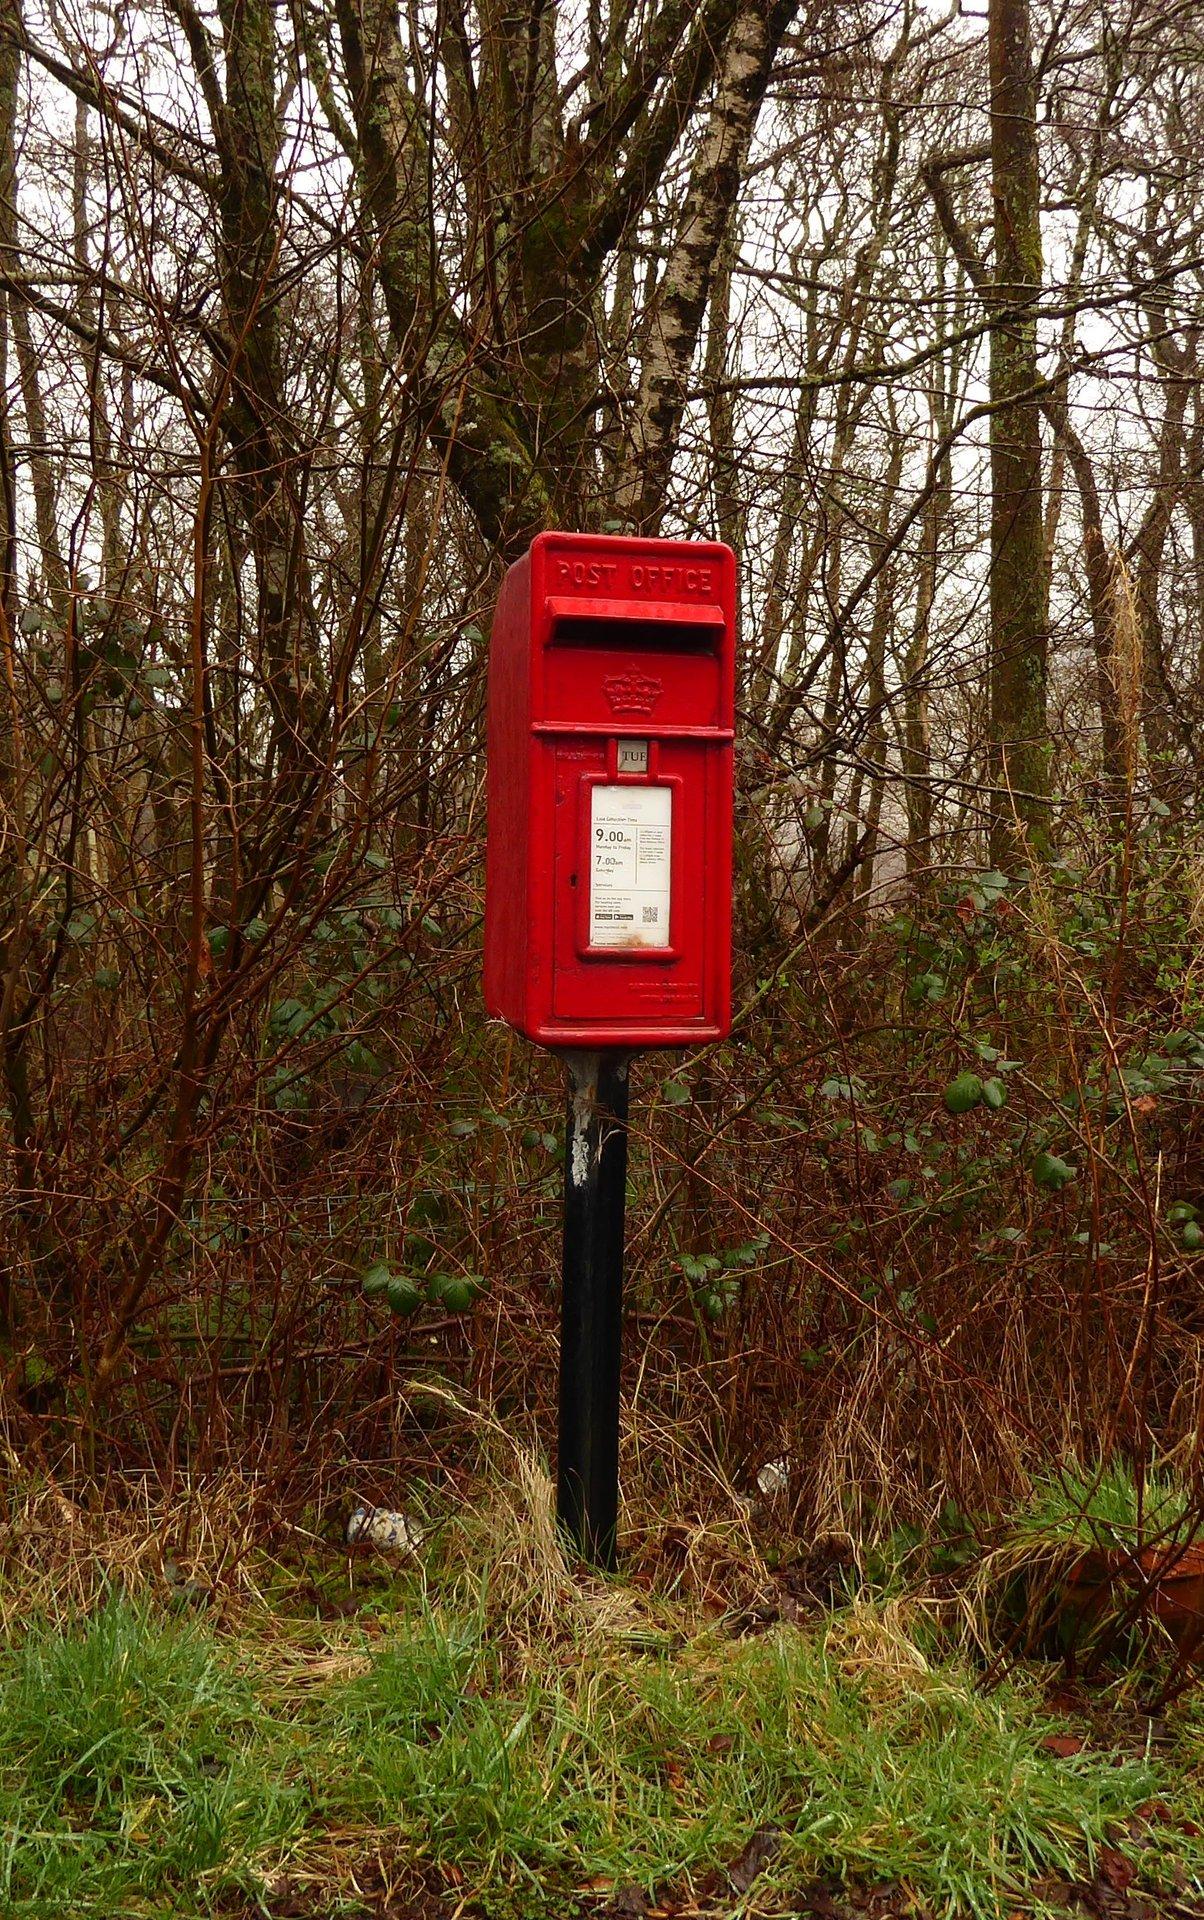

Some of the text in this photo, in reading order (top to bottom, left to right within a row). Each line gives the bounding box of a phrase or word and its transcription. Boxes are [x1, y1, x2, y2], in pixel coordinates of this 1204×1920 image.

[557, 560, 712, 592] POST OFFICE
[623, 751, 647, 761] TUE
